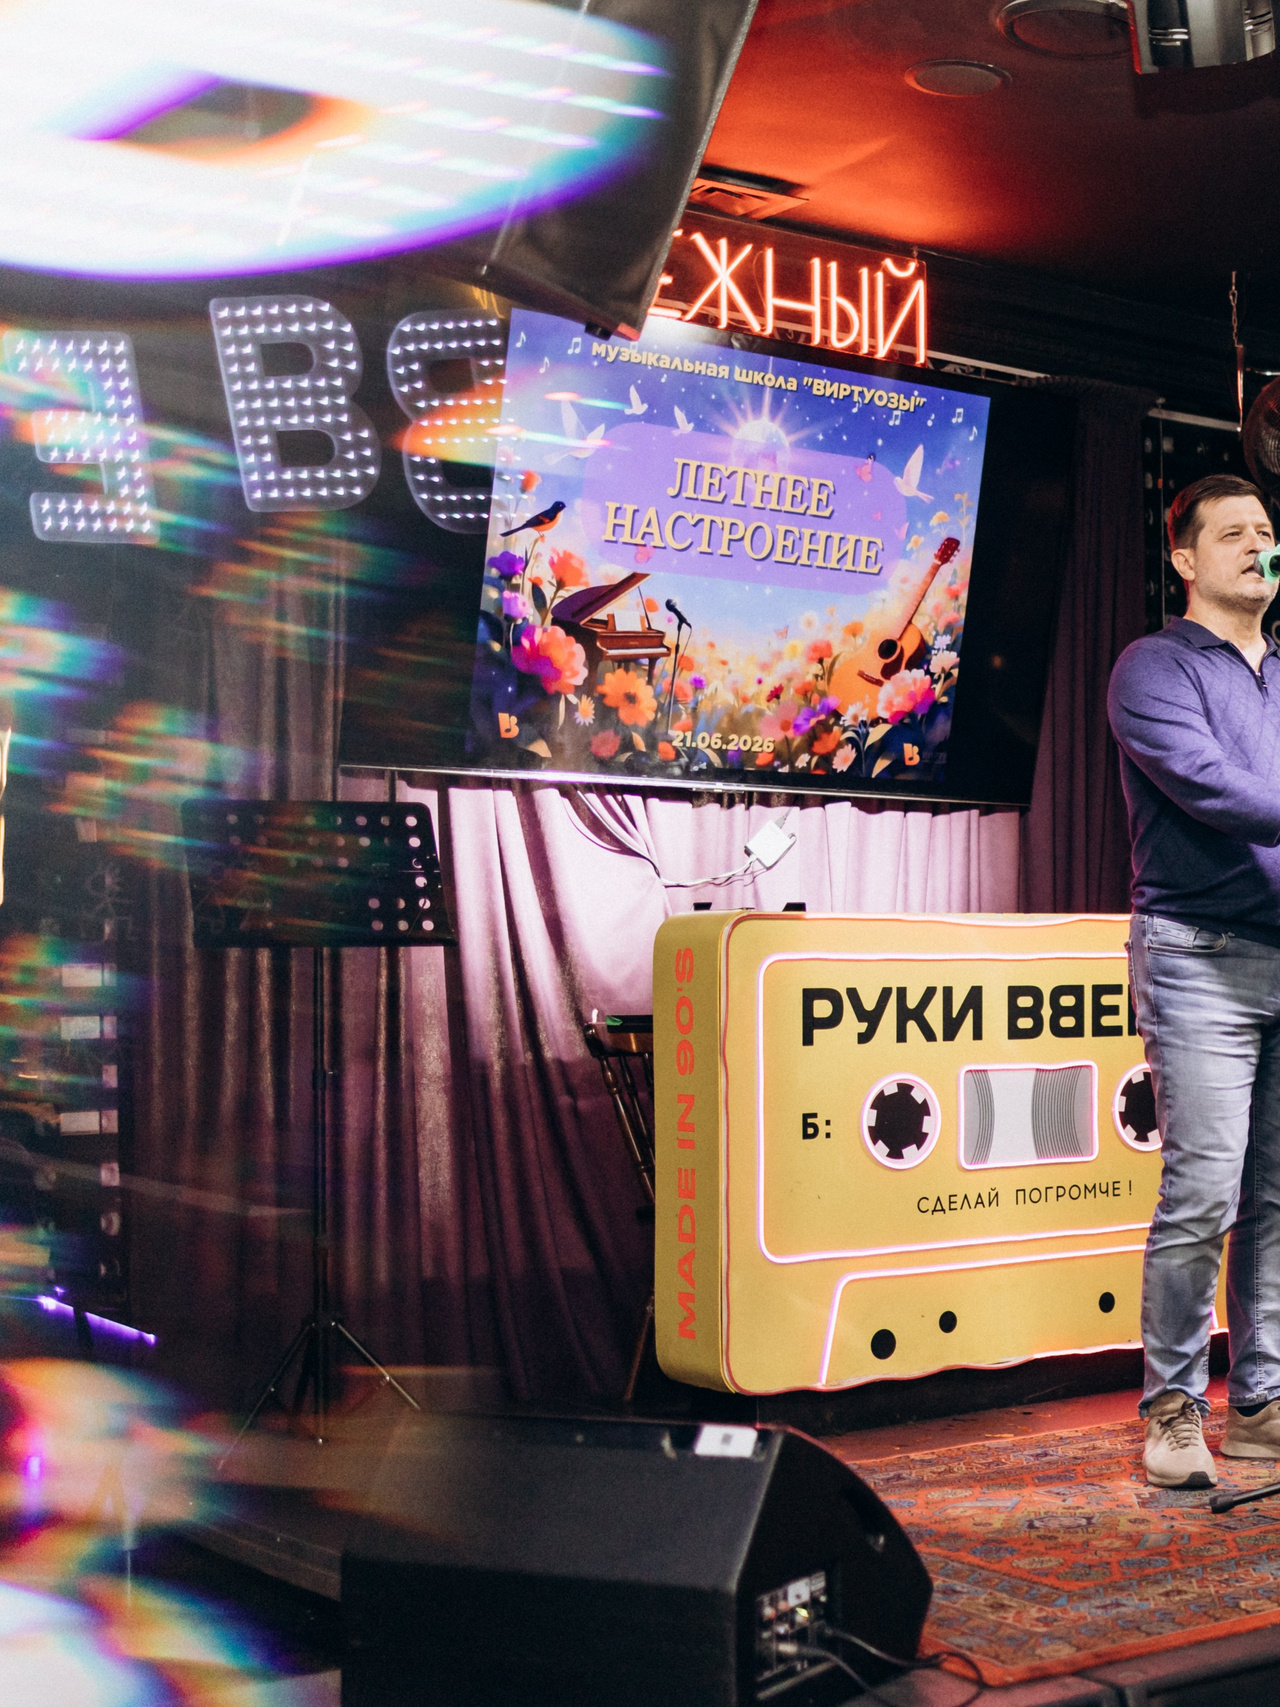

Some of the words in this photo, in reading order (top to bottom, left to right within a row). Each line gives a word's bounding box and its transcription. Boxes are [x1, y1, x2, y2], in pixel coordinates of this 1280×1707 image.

[592, 342, 729, 380] музыкальная
[734, 366, 798, 392] школа
[803, 376, 927, 413] "ВИРТУОЗЫ"
[666, 457, 836, 518] ЛЕТНЕЕ
[602, 501, 884, 575] НАСТРОЕНИЕ
[672, 730, 775, 753] 21.06.2026
[675, 946, 695, 1077] 90'S
[801, 985, 983, 1046] РУКИ
[1008, 984, 1138, 1040] ВВЕ
[677, 1093, 696, 1151] IN
[801, 1112, 832, 1140] Б:
[917, 1187, 999, 1215] СДЕЛАЙ
[678, 1167, 696, 1341] MADE
